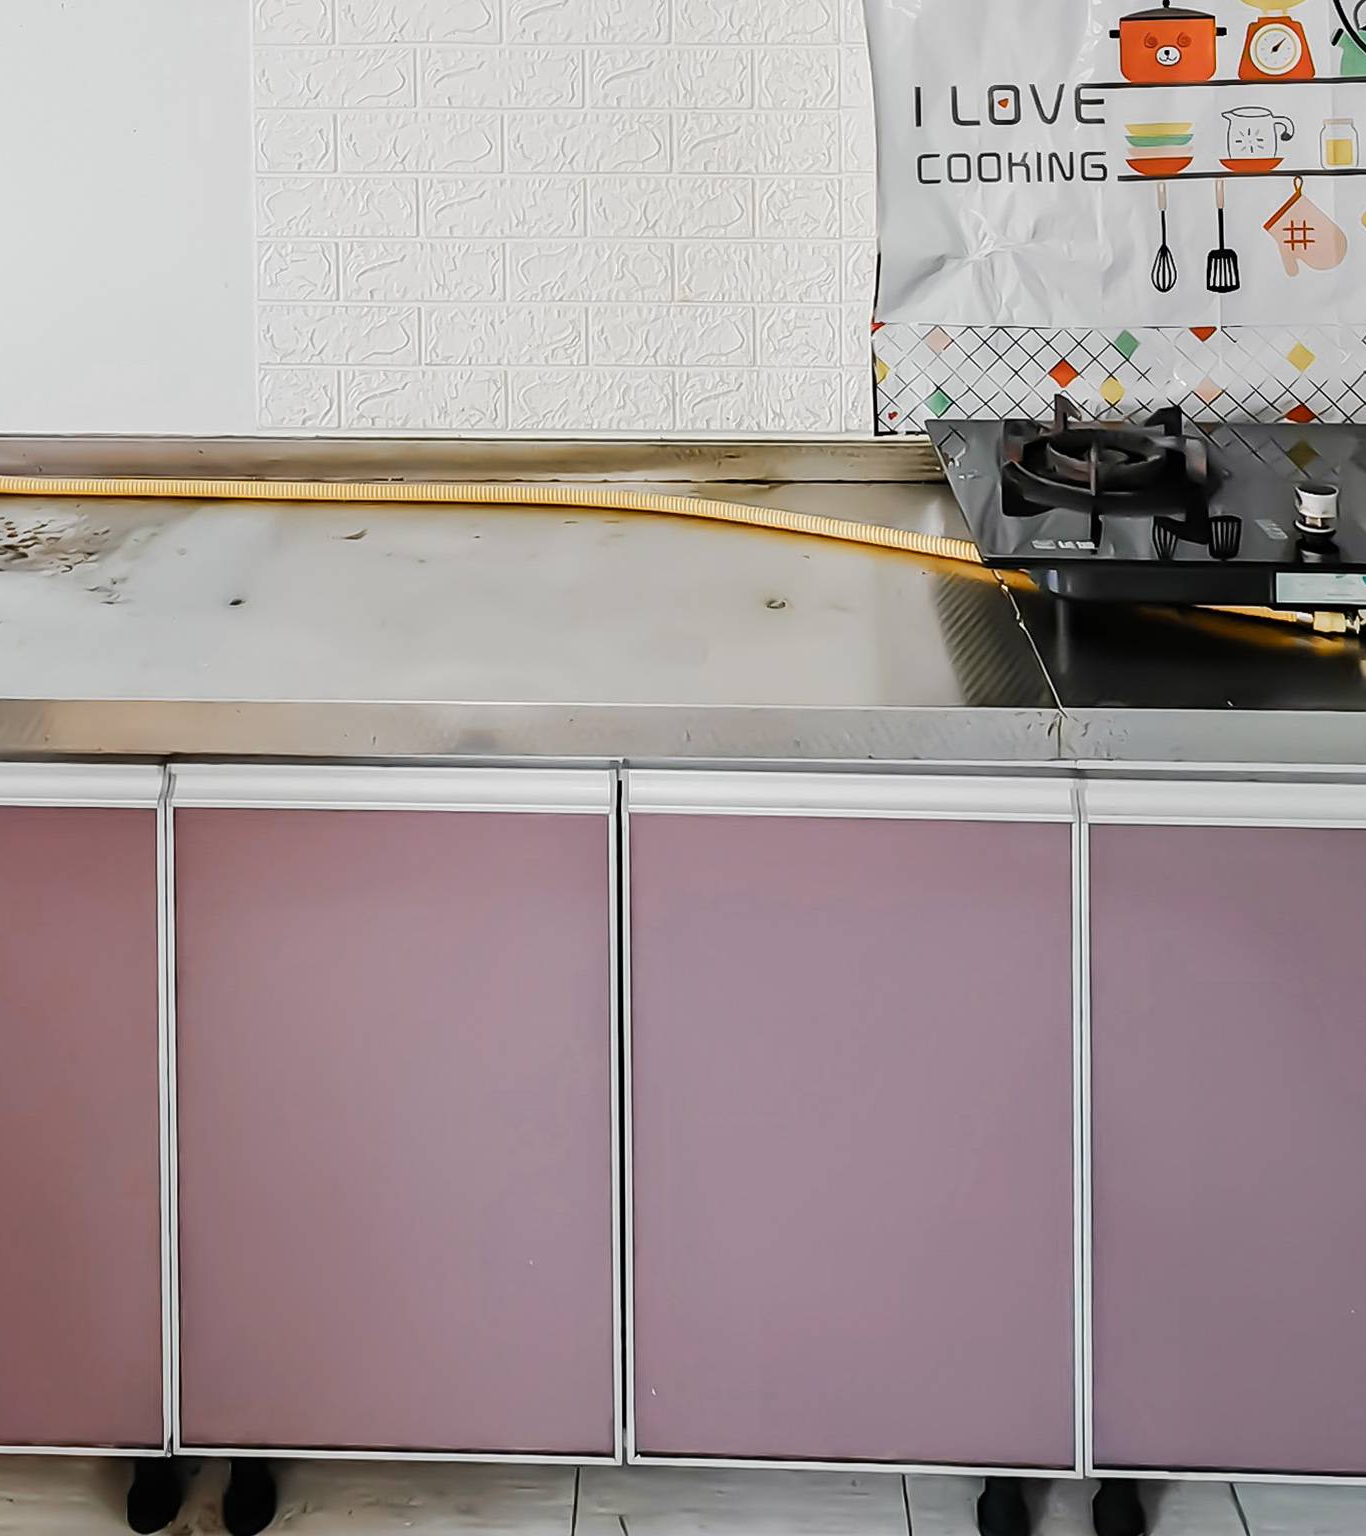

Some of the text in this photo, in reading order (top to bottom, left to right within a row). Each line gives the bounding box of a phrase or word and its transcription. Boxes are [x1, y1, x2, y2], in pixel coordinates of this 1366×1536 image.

[914, 82, 1106, 128] I LOVE
[917, 151, 1108, 184] COOKING
